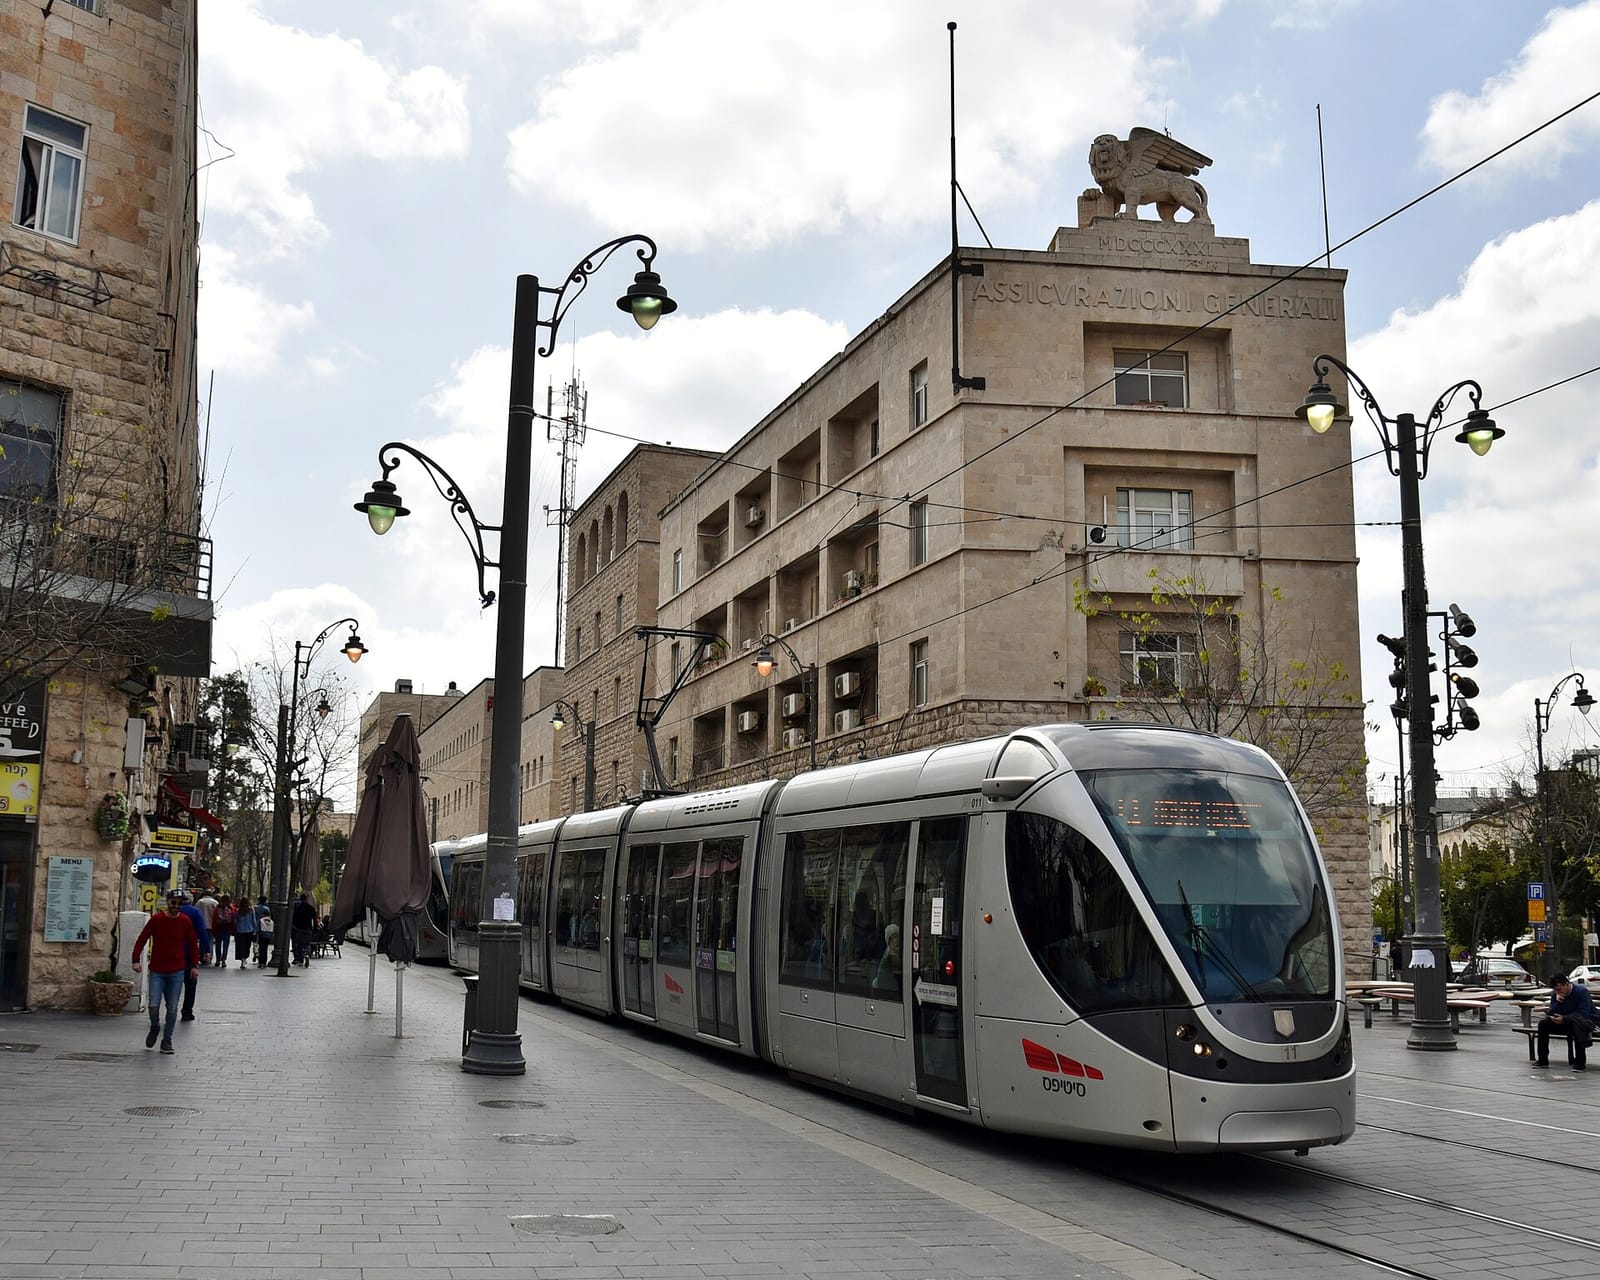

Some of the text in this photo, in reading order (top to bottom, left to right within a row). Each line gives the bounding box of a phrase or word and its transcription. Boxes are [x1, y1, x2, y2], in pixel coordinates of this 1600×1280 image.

[1099, 235, 1212, 257] MDCCCXXXI
[972, 281, 1338, 321] ASSICVRAZIONI GENERALI
[5, 764, 28, 776] קפה
[136, 857, 170, 869] CHANGE
[1042, 1076, 1086, 1097] סיטיפס
